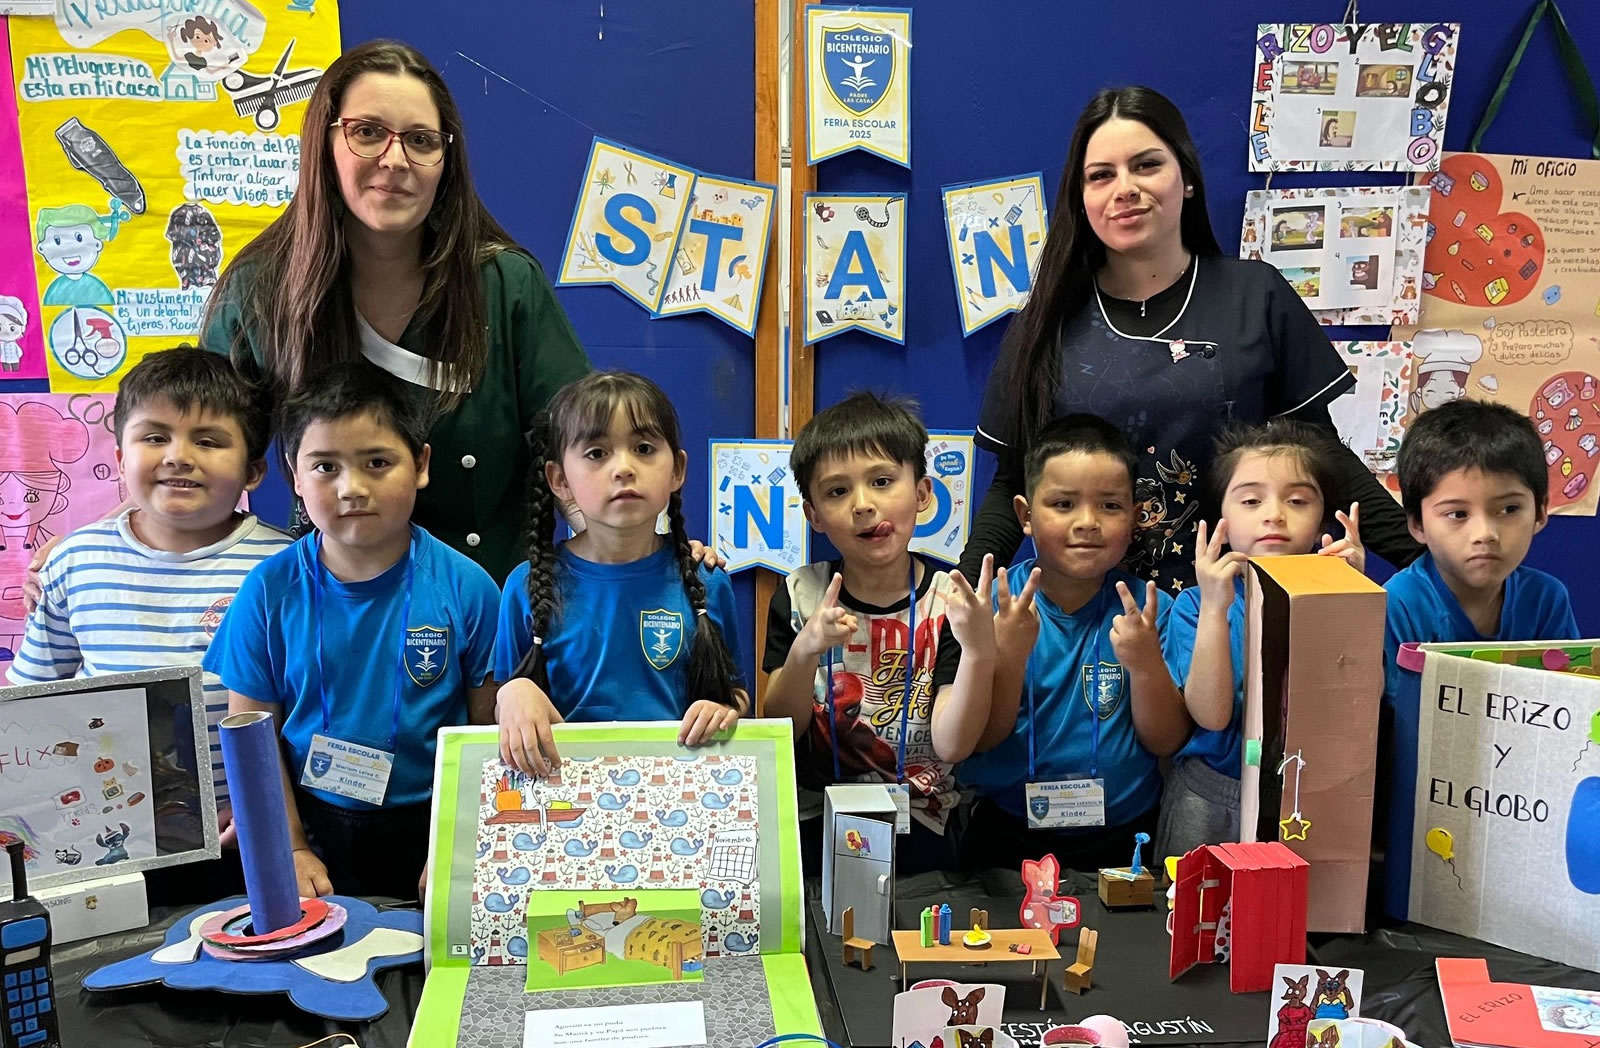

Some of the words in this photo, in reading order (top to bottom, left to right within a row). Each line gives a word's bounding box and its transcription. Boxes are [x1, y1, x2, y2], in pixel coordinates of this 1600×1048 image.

[834, 34, 883, 43] COLEGIO
[826, 43, 890, 55] BICENTENARIO
[824, 118, 849, 128] FERIA
[852, 119, 896, 129] ESCOLAR
[849, 130, 872, 139] 2025
[185, 136, 203, 149] La
[263, 138, 282, 153] del
[189, 153, 202, 165] es
[193, 183, 229, 199] hacer
[117, 290, 131, 304] Mi
[118, 307, 130, 317] es
[136, 308, 150, 317] un
[1496, 325, 1515, 340] Soy
[643, 621, 680, 629] BICENTENARIO
[407, 638, 446, 646] BICENTENARIO
[1438, 684, 1471, 716] EL
[328, 742, 347, 752] FERIA
[348, 747, 380, 760] ESCOLAR
[1494, 743, 1512, 769] Y
[340, 777, 366, 788] Kinder
[1429, 777, 1459, 809] EL
[1464, 785, 1549, 823] GLOBO
[715, 836, 752, 844] Noviembre
[1458, 1010, 1482, 1024] EL
[1476, 992, 1523, 1017] ERIZO
